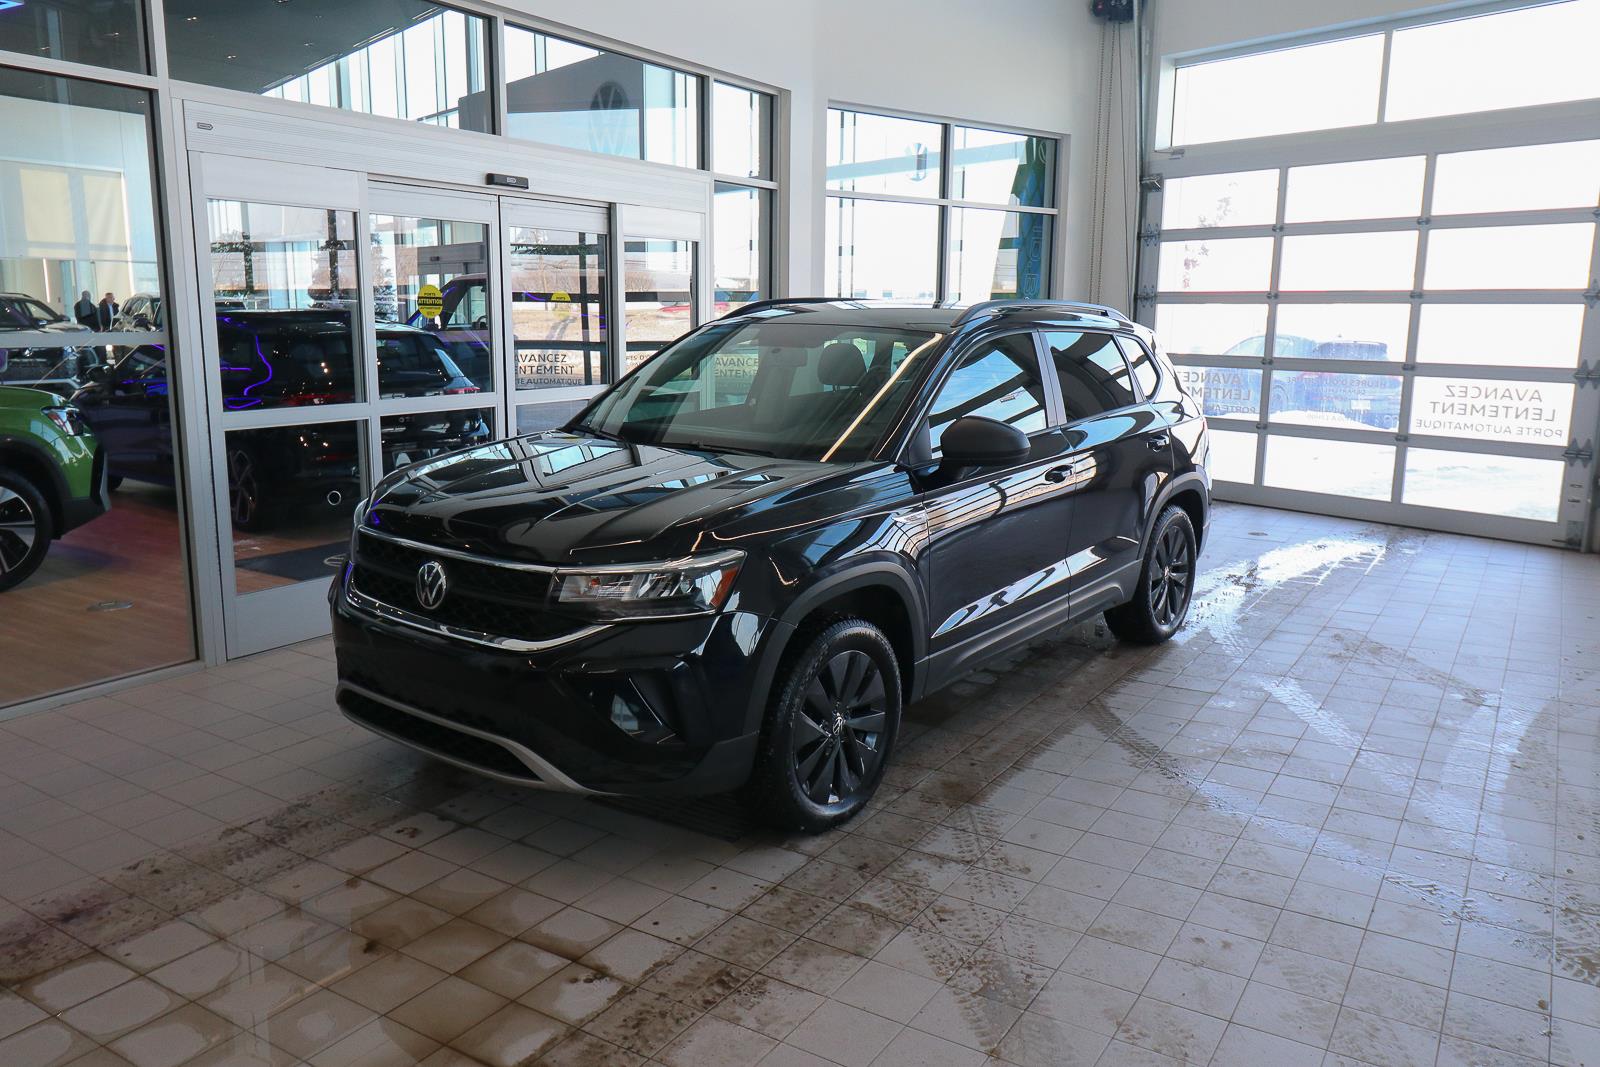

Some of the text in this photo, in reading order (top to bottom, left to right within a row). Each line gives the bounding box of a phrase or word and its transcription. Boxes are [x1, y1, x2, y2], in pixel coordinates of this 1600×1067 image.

[514, 353, 567, 363] AVANCEZ
[714, 357, 760, 367] AVANCE
[515, 365, 575, 375] ENTEMENT
[526, 377, 583, 386] AUTOMATIQUE
